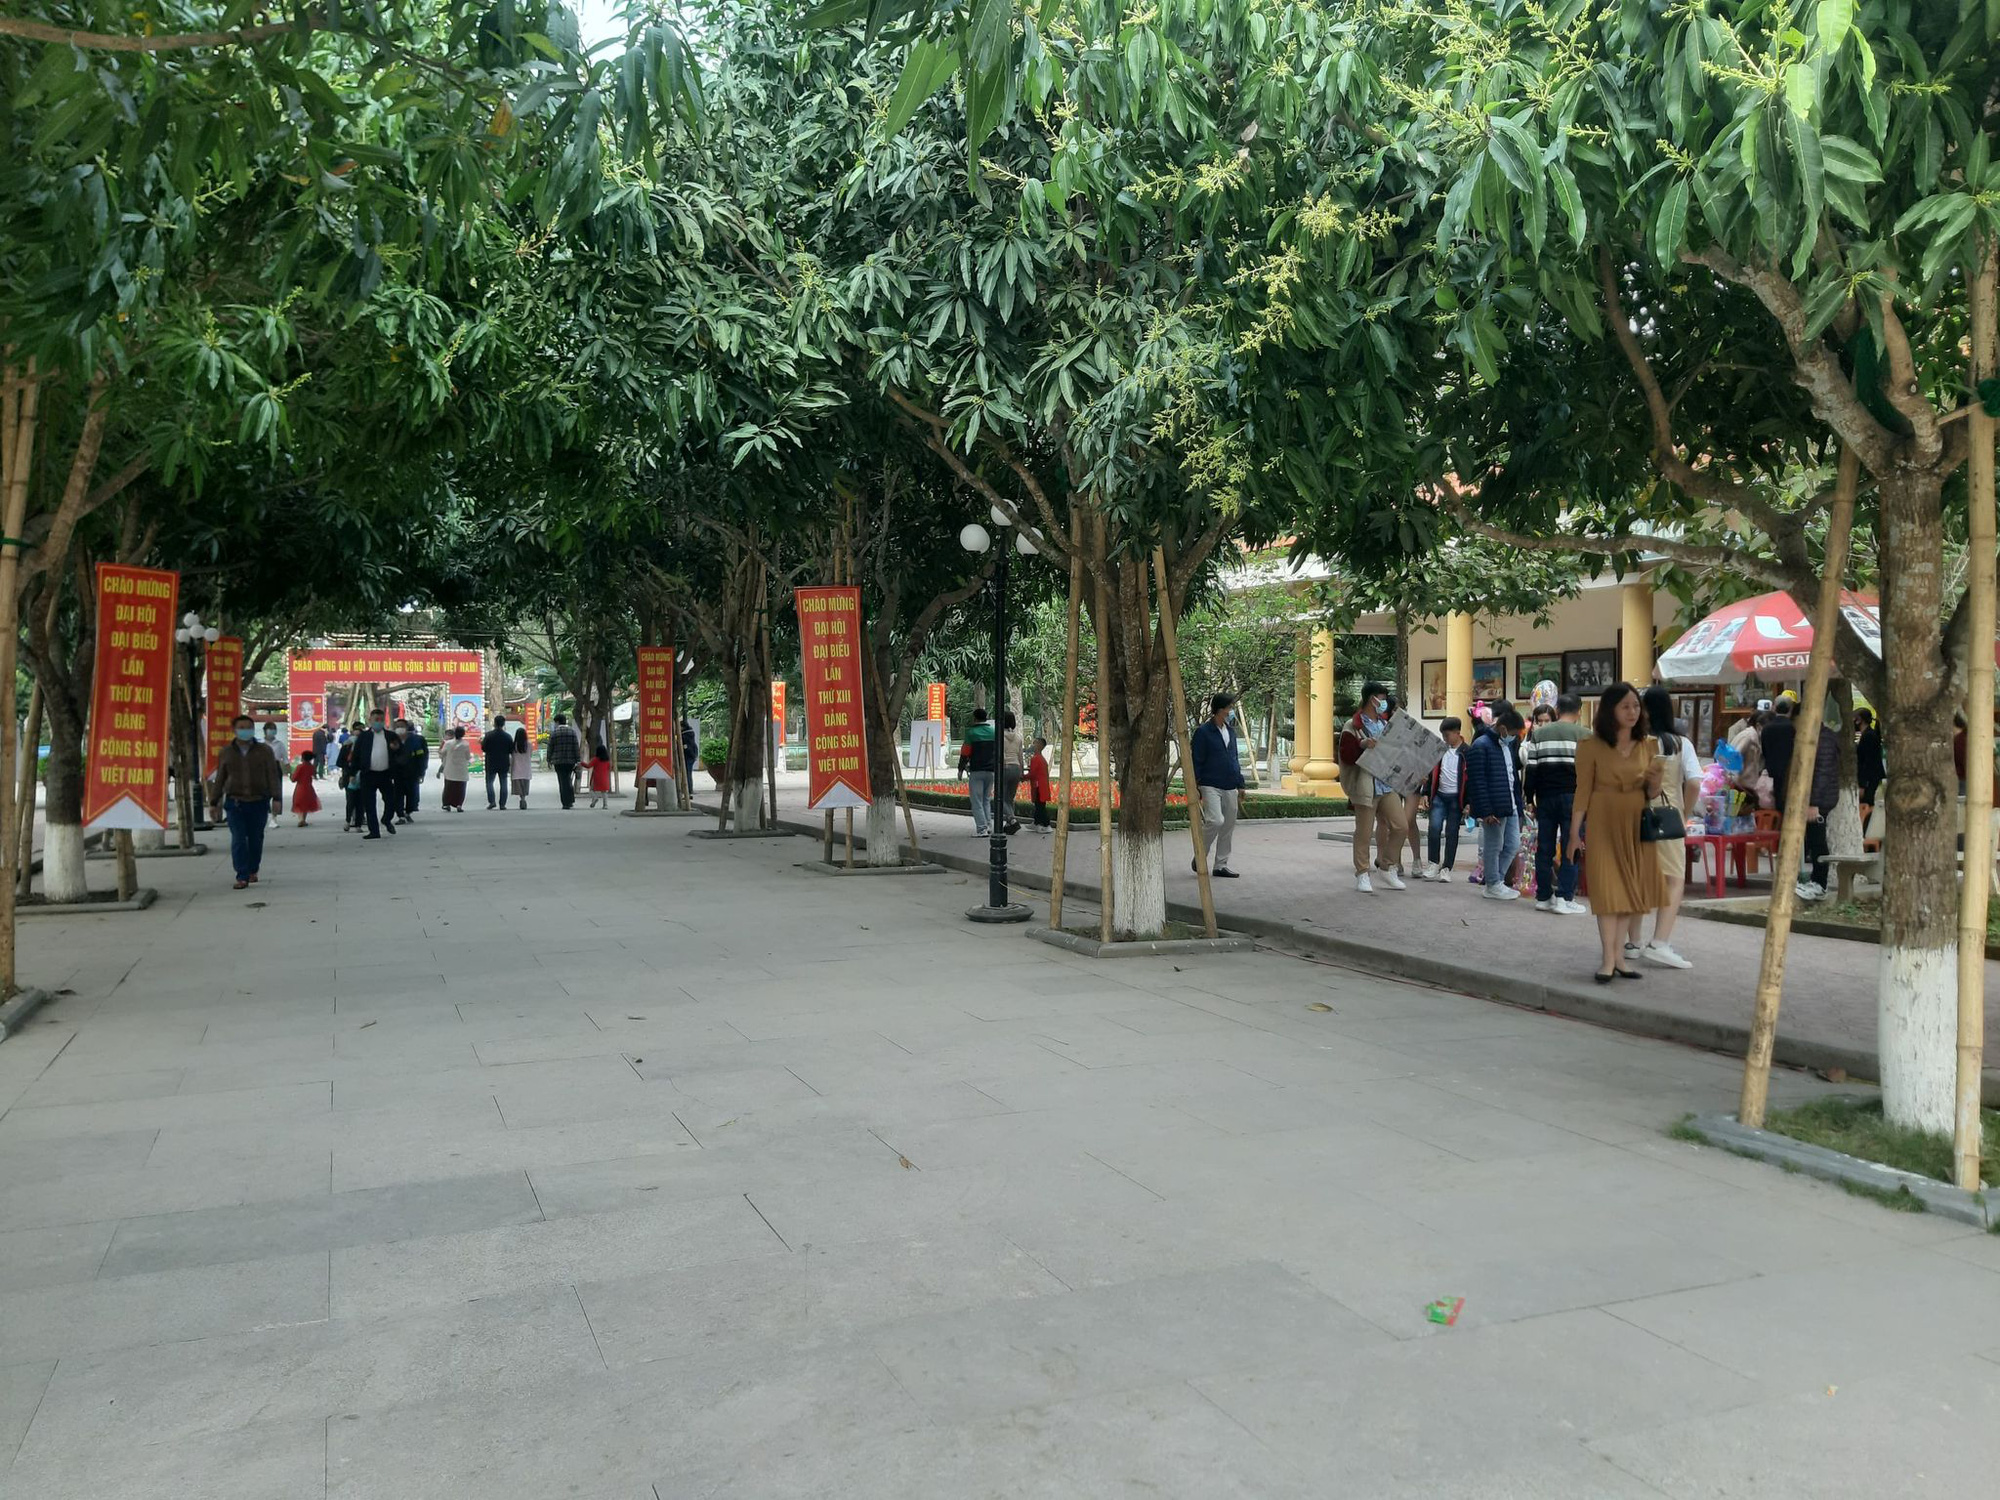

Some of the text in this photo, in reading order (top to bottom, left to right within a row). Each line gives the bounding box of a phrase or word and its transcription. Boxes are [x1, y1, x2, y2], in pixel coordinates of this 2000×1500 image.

[104, 575, 170, 599] CHÀO MỪNG
[802, 594, 855, 612] CHÀO MỪNG
[115, 604, 156, 626] ĐẠI HỘI
[110, 628, 158, 650] ĐẠI BIỂU
[814, 618, 846, 638] ĐẠI HỘI
[813, 638, 850, 662] ĐẠI BIỂU
[110, 683, 153, 704] THỨ XIII
[818, 688, 851, 704] THỨ XIII
[114, 708, 146, 730] ĐẢNG
[824, 709, 848, 726] ĐẢNG
[100, 735, 158, 760] CỘNG SẢN
[815, 731, 859, 753] CỘNG SẢN
[101, 764, 154, 787] VIỆT NAM
[818, 756, 859, 774] VIỆT NAM
